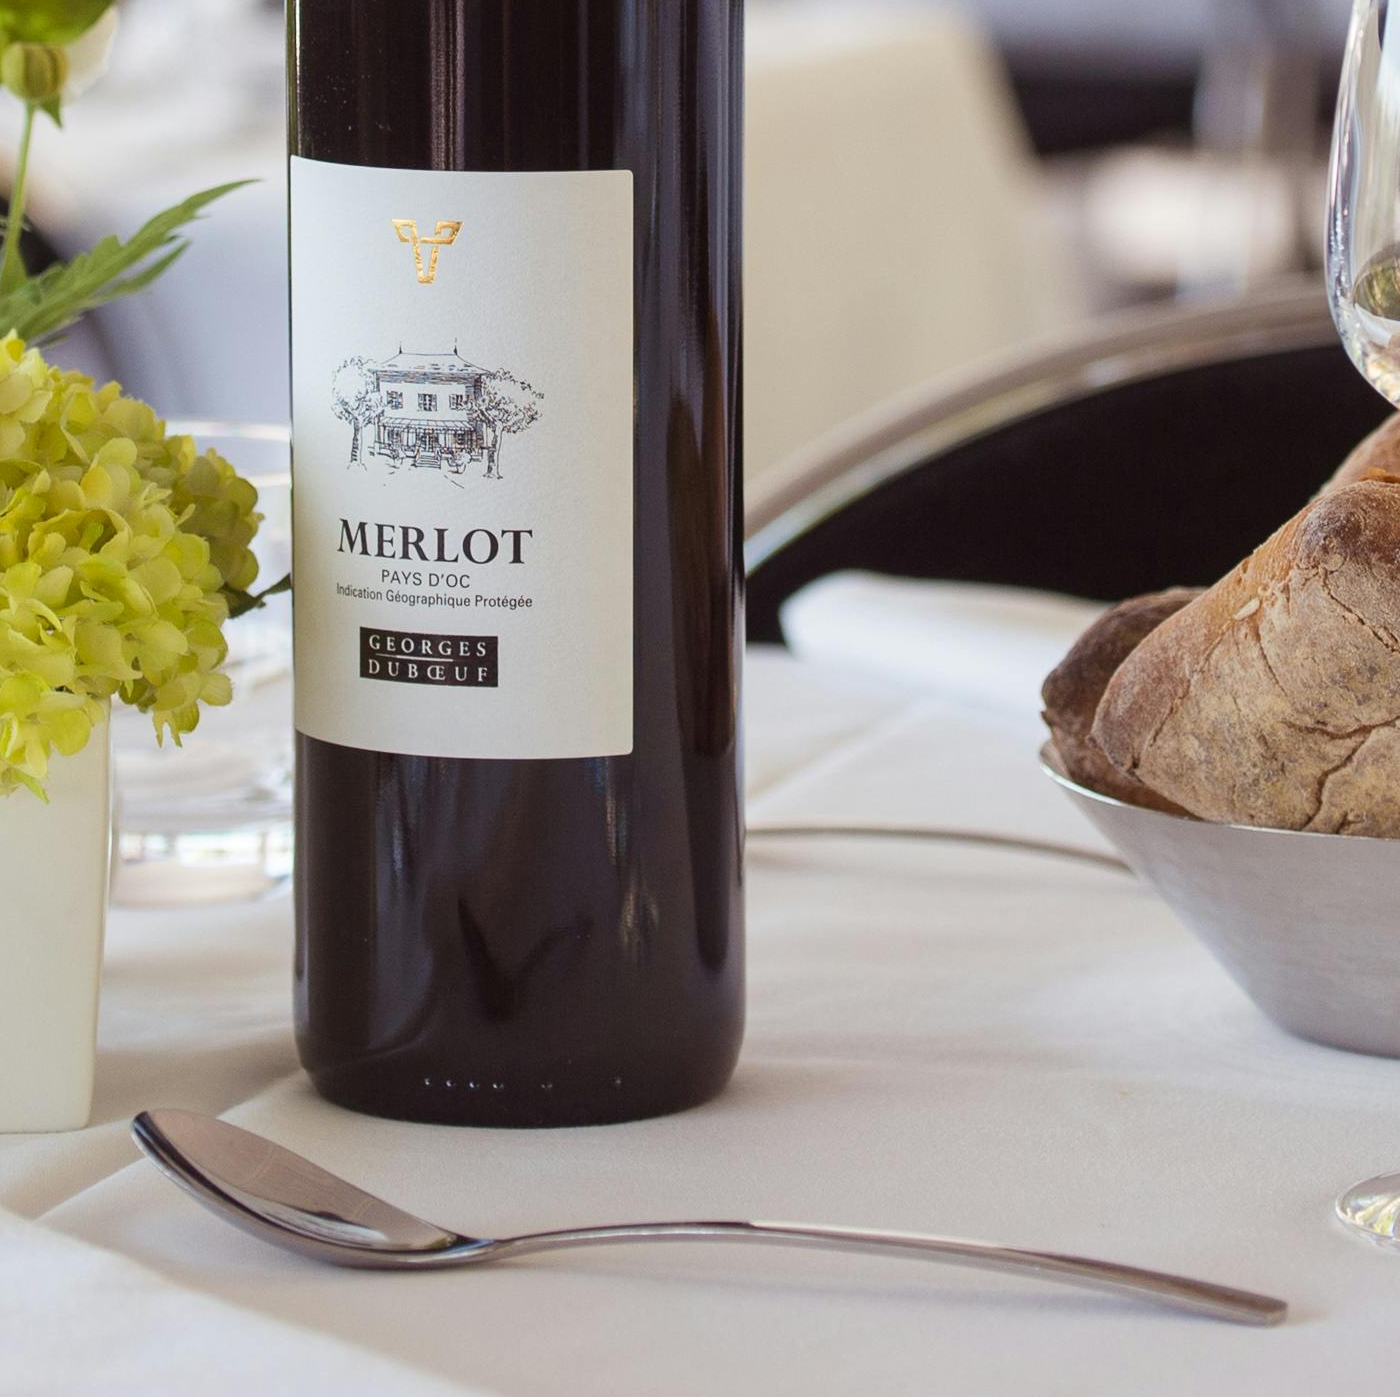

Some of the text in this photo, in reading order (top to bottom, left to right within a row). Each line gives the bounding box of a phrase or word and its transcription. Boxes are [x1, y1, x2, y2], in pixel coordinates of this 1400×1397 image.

[337, 518, 533, 564] MERLOT
[381, 569, 471, 588] PAYS D'OC
[336, 583, 533, 610] Indication Géographique Protégée
[368, 635, 487, 657] GEORGES
[368, 659, 488, 682] DUBŒUF
